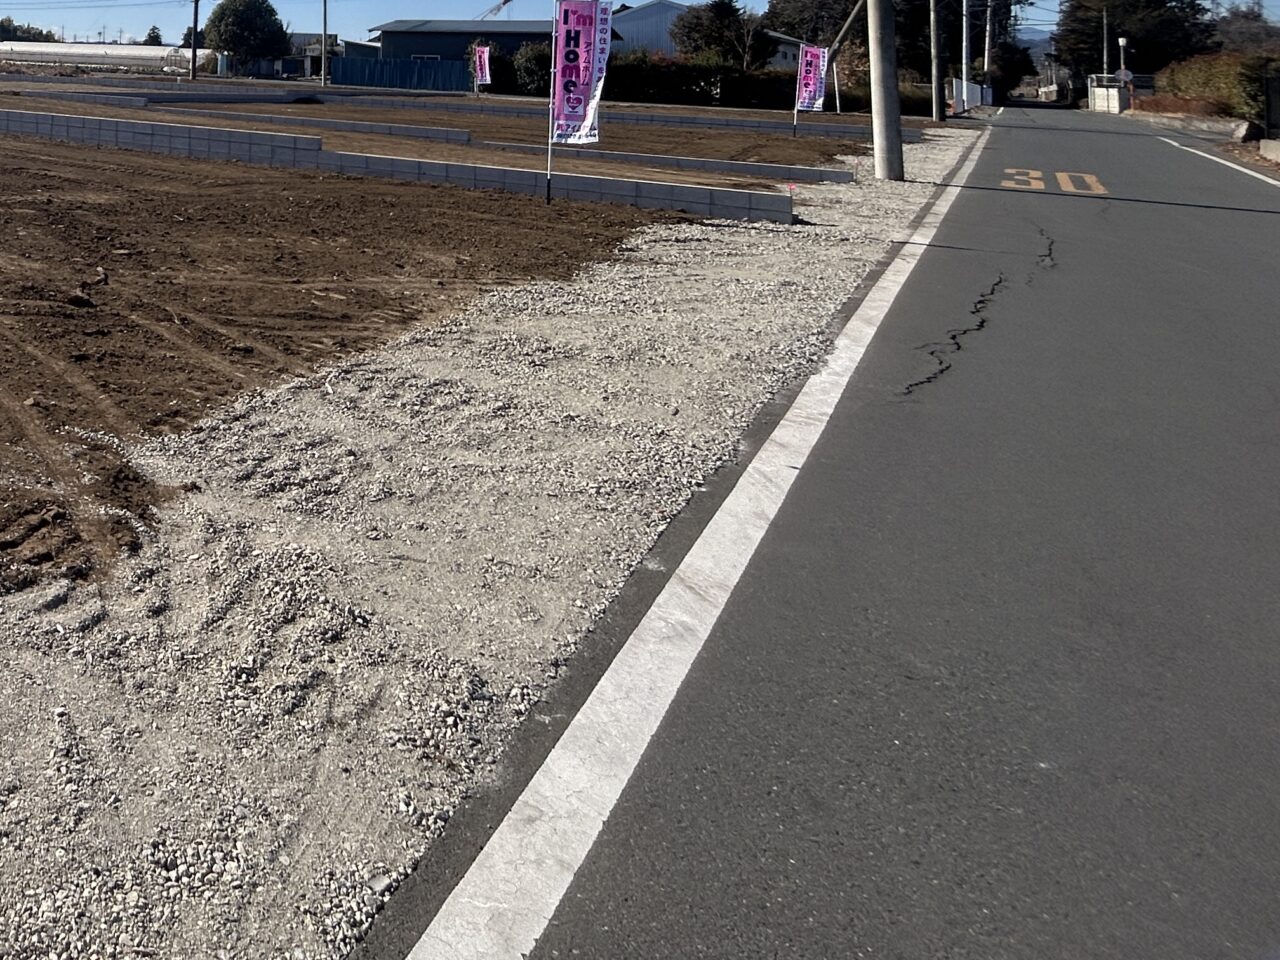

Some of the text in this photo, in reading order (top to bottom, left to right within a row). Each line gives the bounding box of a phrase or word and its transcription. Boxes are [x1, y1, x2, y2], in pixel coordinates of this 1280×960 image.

[562, 8, 594, 27] I'm
[560, 29, 581, 94] Home
[581, 41, 593, 87] アイムホーム
[804, 50, 820, 60] I'm
[803, 59, 813, 89] Home
[1000, 168, 1109, 195] 30
